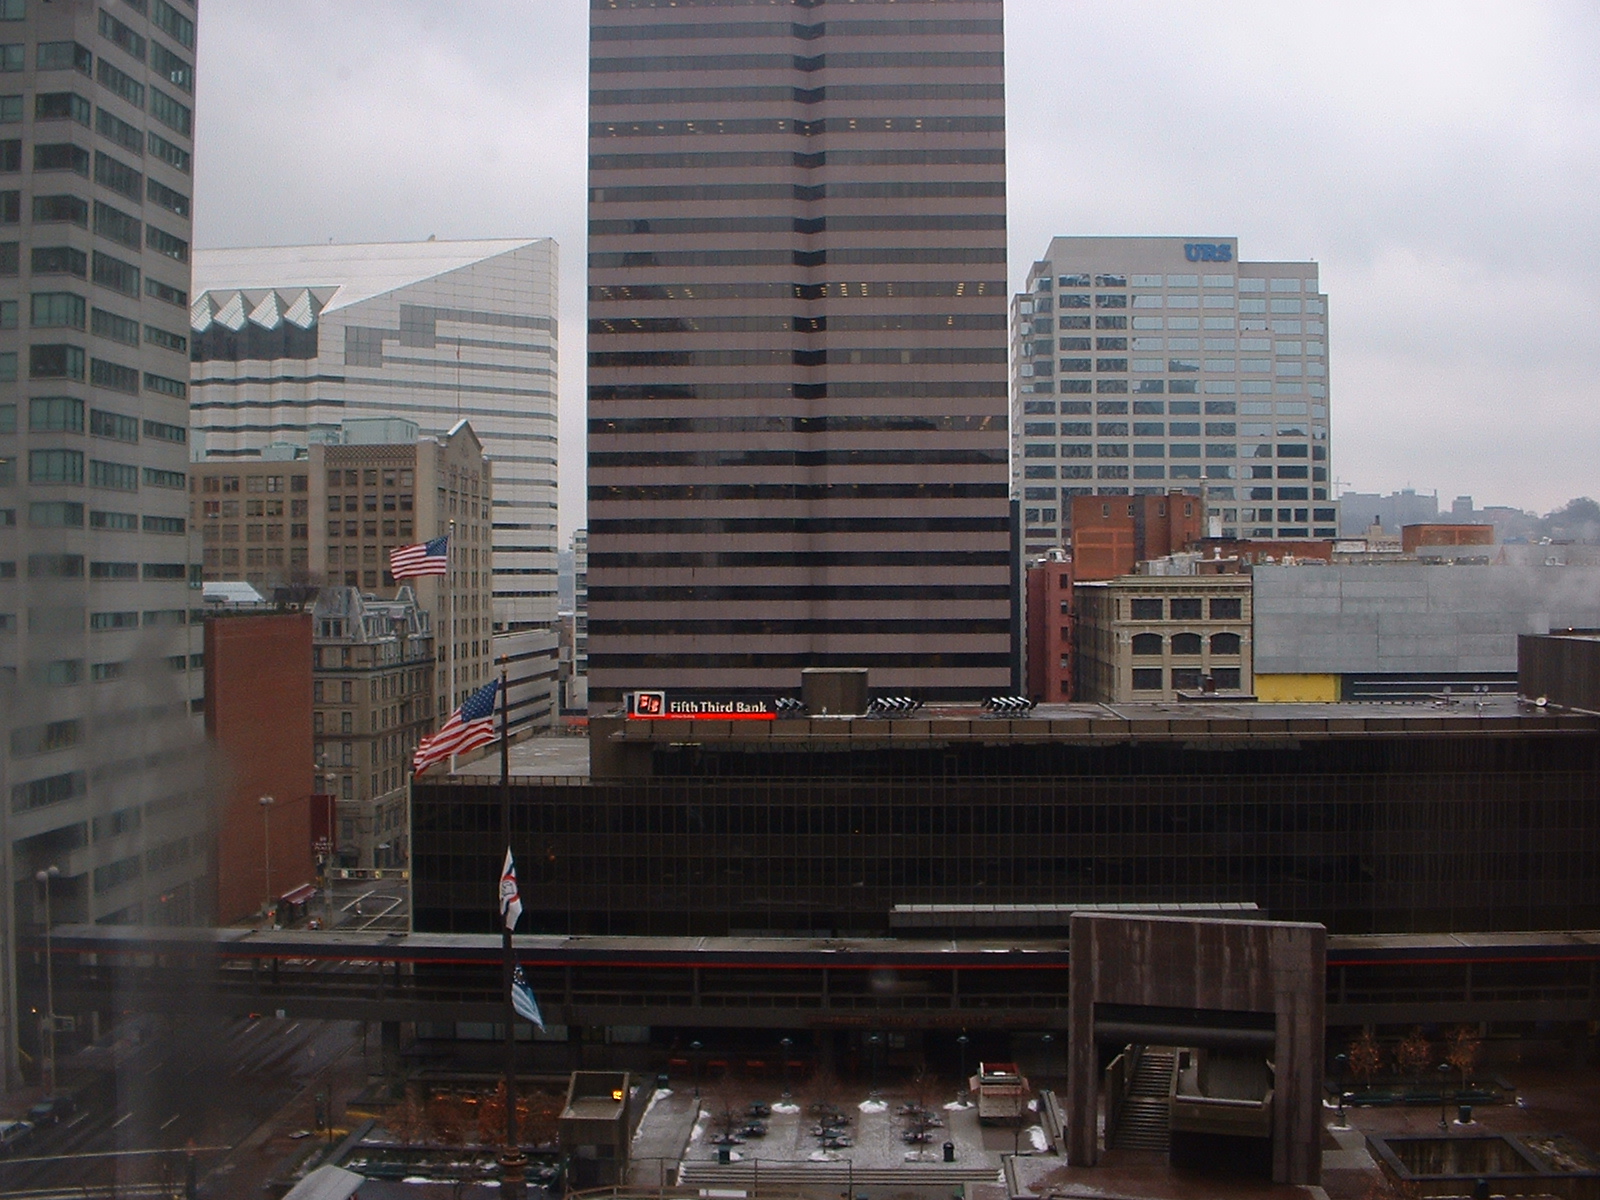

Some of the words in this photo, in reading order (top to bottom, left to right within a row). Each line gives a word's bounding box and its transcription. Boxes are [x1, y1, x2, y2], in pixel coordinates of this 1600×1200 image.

[1184, 243, 1232, 262] URS
[670, 701, 698, 712] Fifth
[699, 701, 733, 712] Third
[736, 701, 767, 712] Bank
